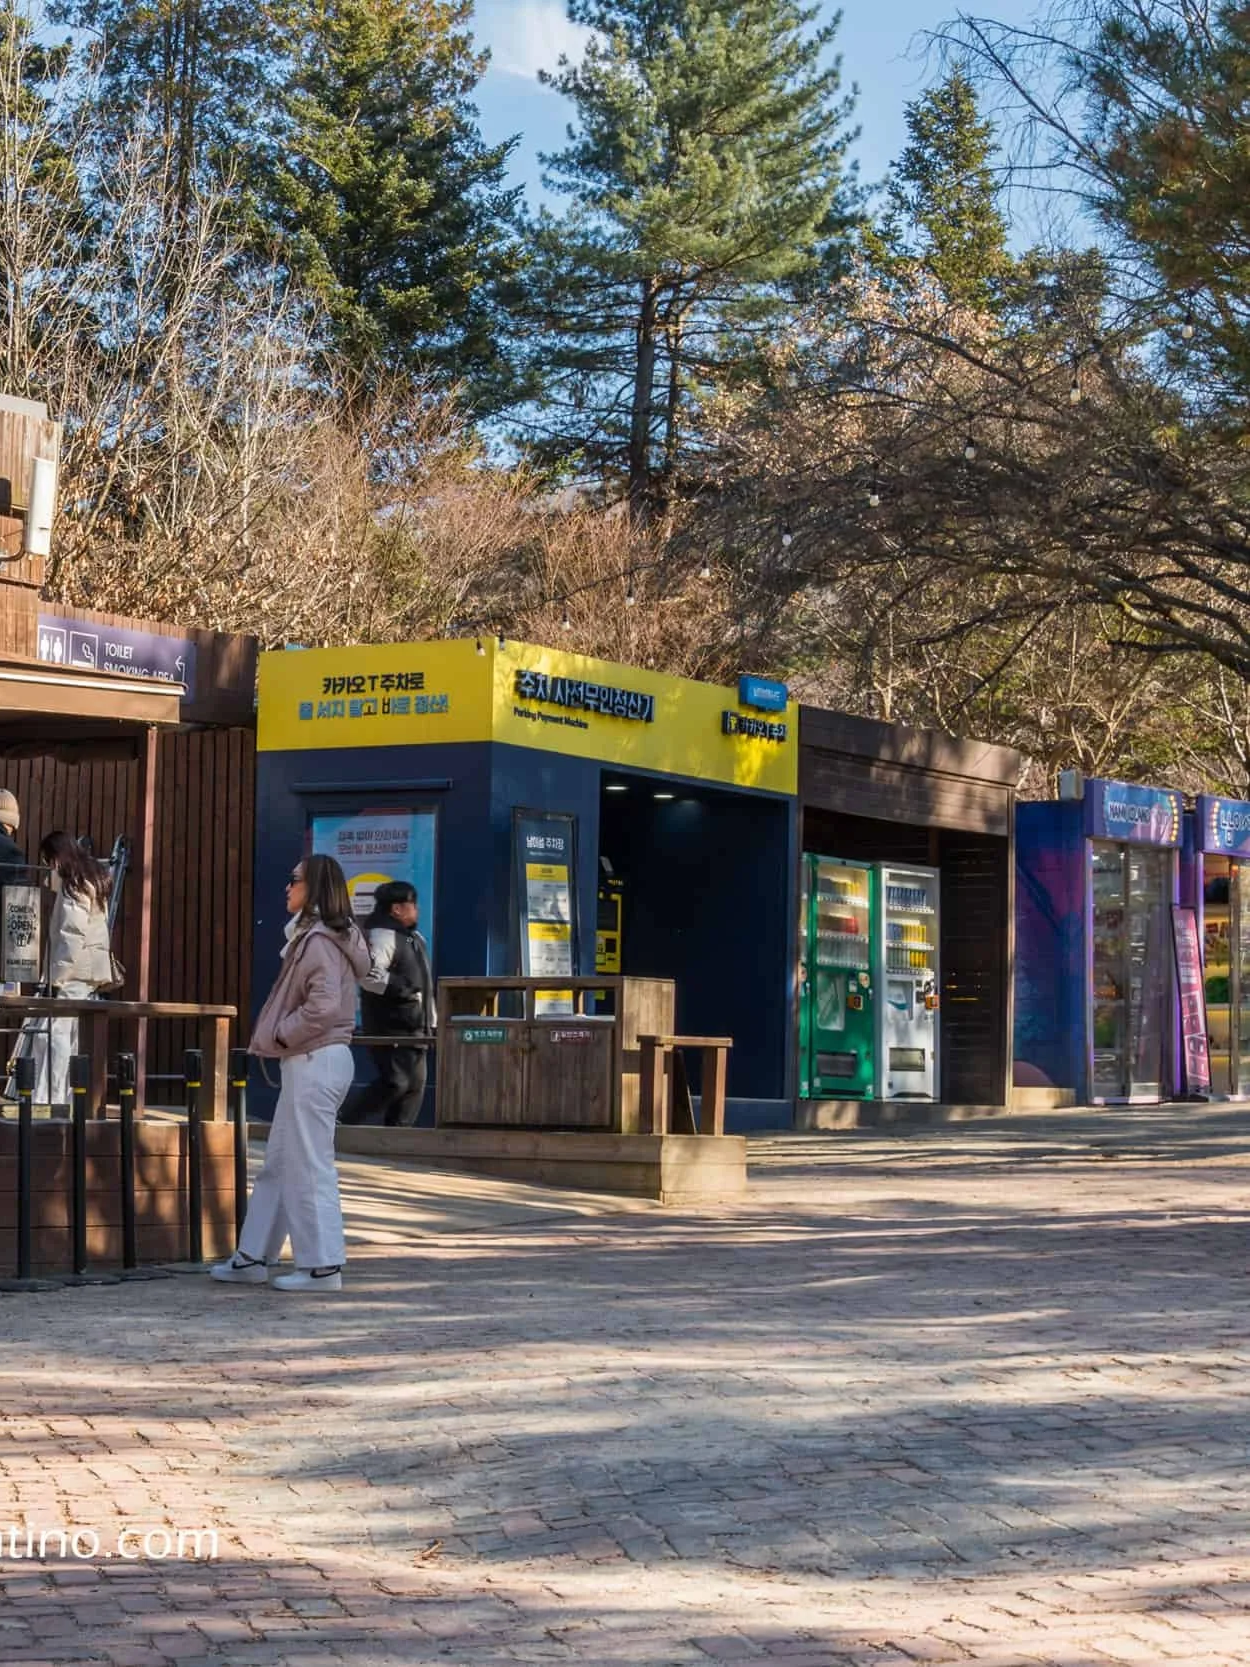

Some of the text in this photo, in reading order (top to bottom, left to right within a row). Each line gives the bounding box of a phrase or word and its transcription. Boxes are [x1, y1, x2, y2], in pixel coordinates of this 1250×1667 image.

[105, 642, 133, 659] TOILET
[104, 662, 150, 678] SMOKING
[323, 676, 366, 694] 카카오
[381, 672, 425, 691] 주차로
[516, 670, 655, 722] 주차 사전무인정산기
[513, 706, 536, 721] Parking
